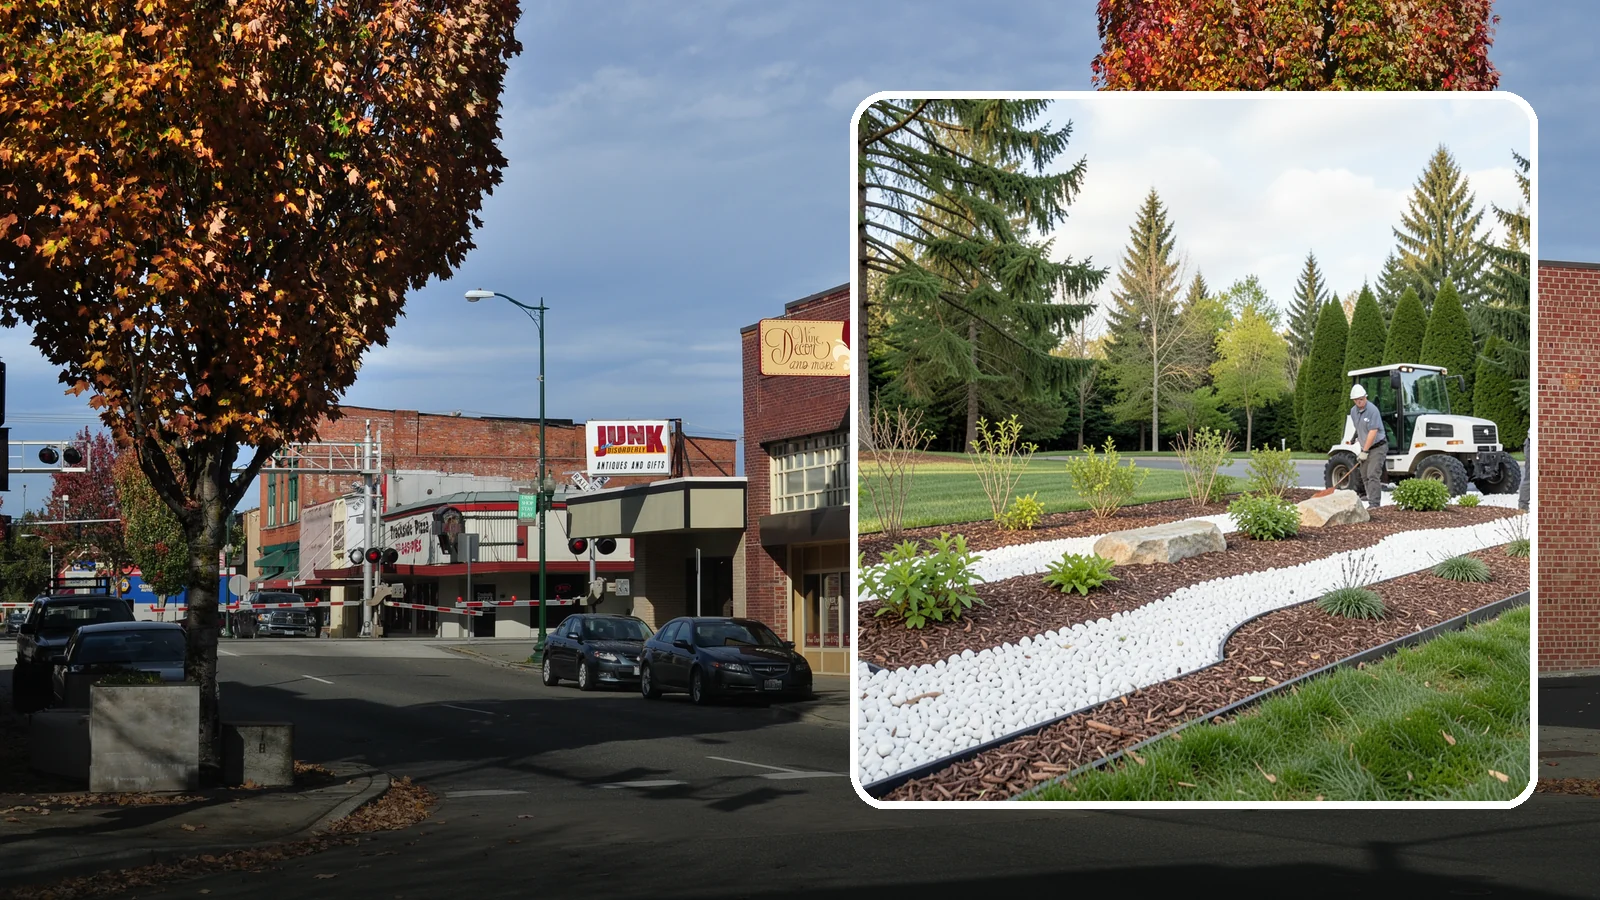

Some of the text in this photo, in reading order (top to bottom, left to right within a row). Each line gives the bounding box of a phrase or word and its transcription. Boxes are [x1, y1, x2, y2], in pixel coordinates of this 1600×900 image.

[595, 425, 664, 457] JUNK
[607, 446, 646, 454] DISORDERLY
[597, 460, 665, 470] ANTIQUES AND GIFTS
[415, 519, 429, 535] Pizza
